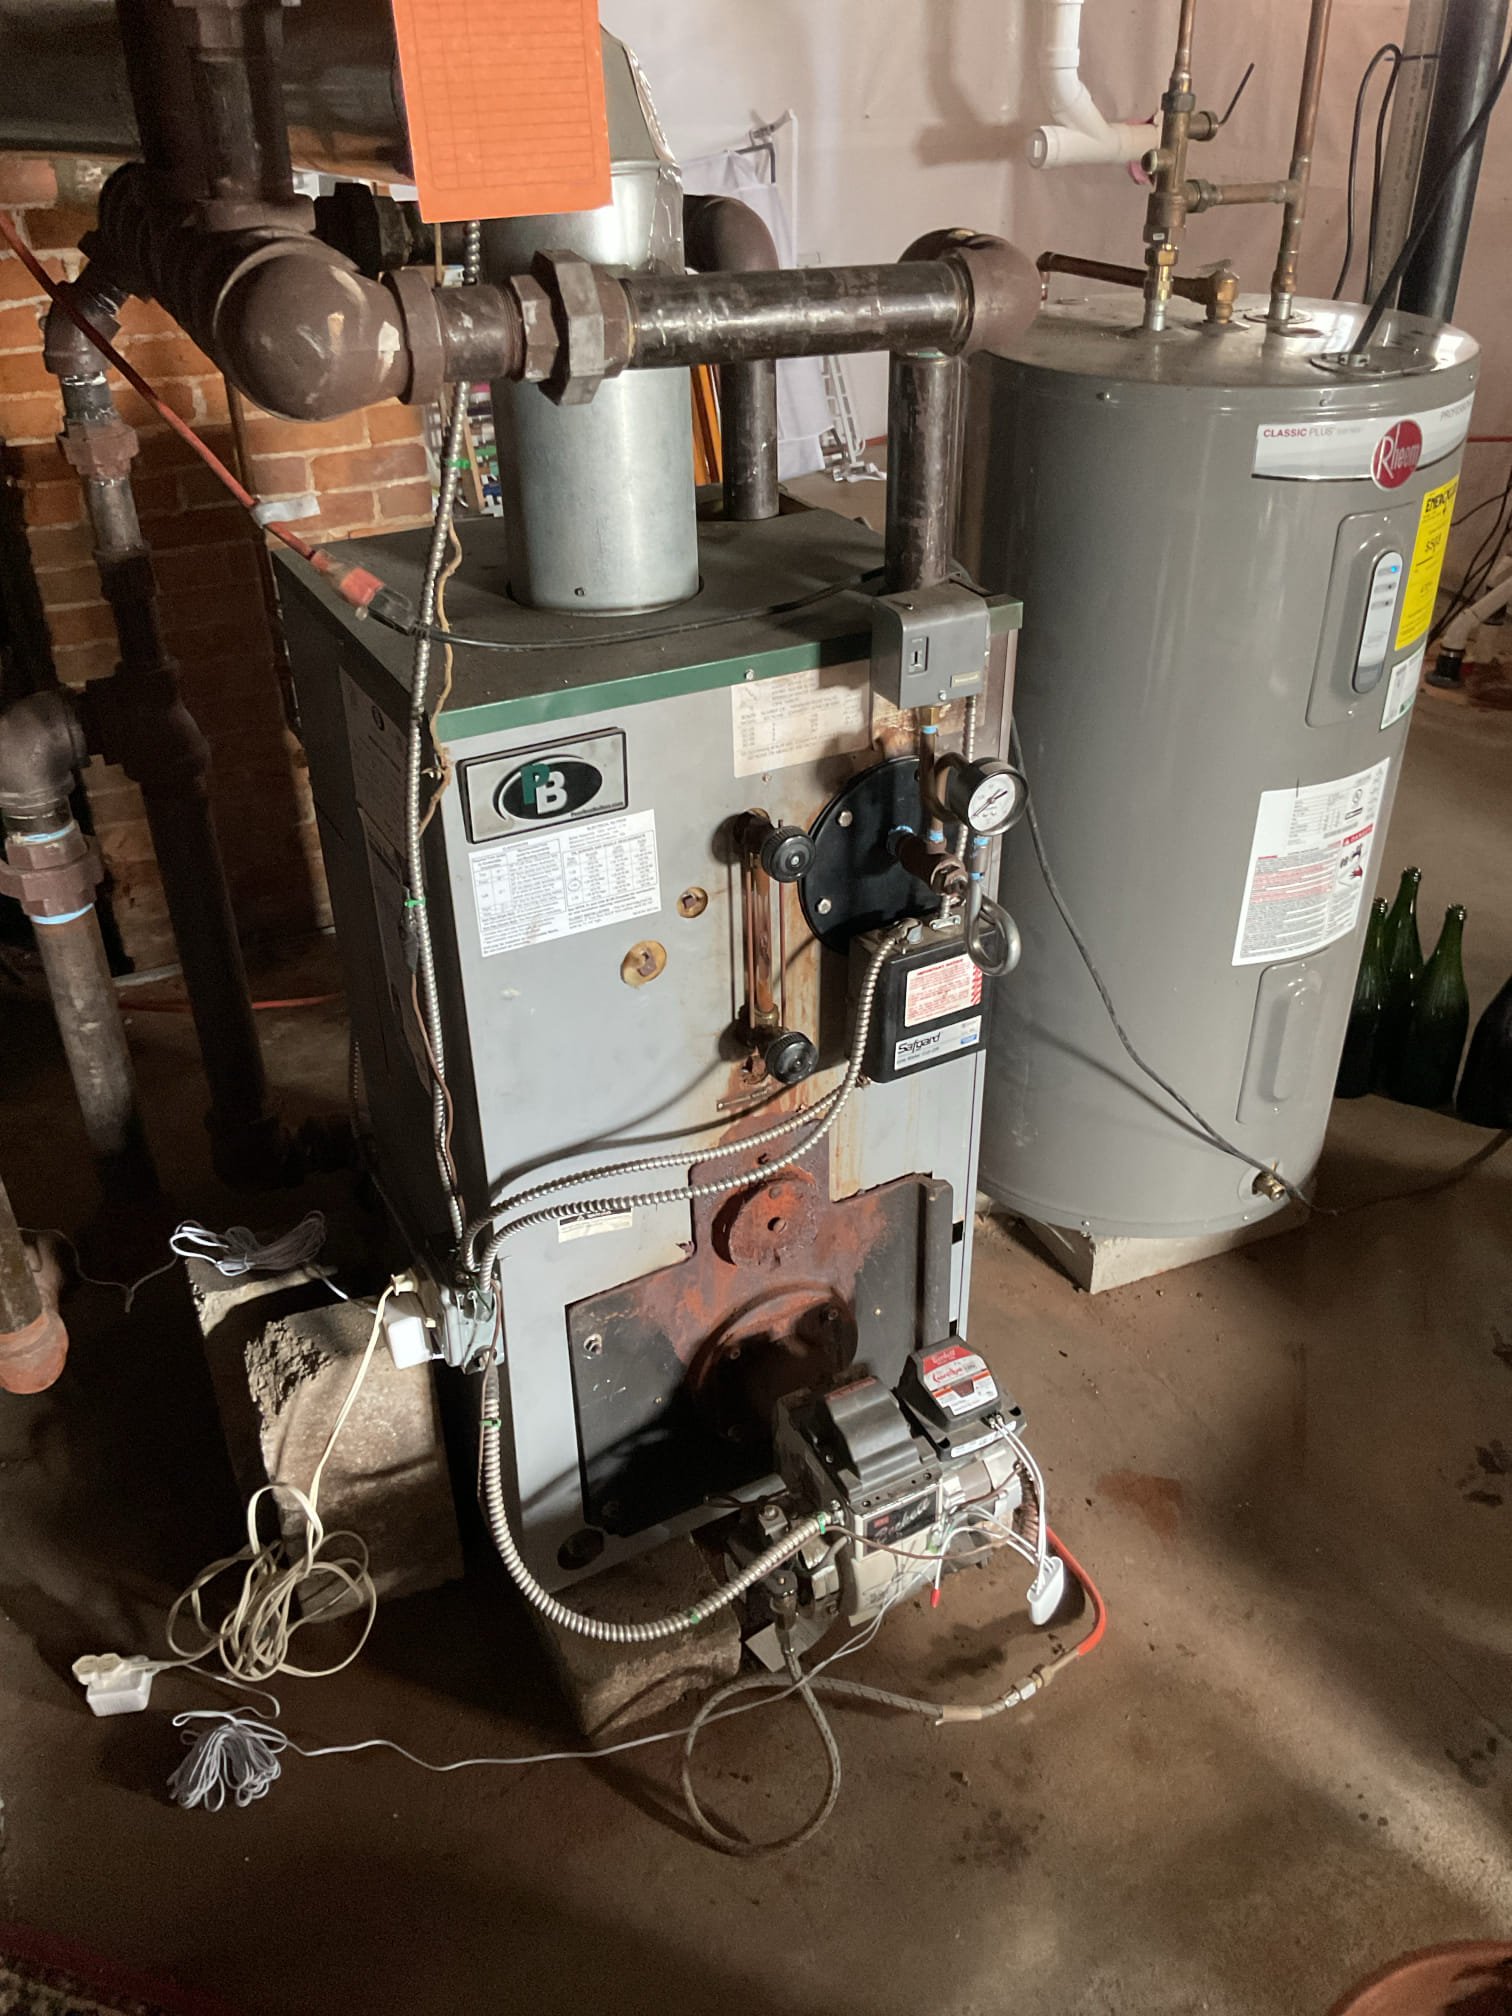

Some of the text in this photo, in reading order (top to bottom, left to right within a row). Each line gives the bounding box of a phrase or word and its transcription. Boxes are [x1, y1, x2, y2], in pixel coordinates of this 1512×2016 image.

[1263, 427, 1308, 438] CLASSIC
[1308, 426, 1331, 437] PLUS
[1376, 423, 1420, 480] Rheem
[897, 1032, 941, 1054] Safgard
